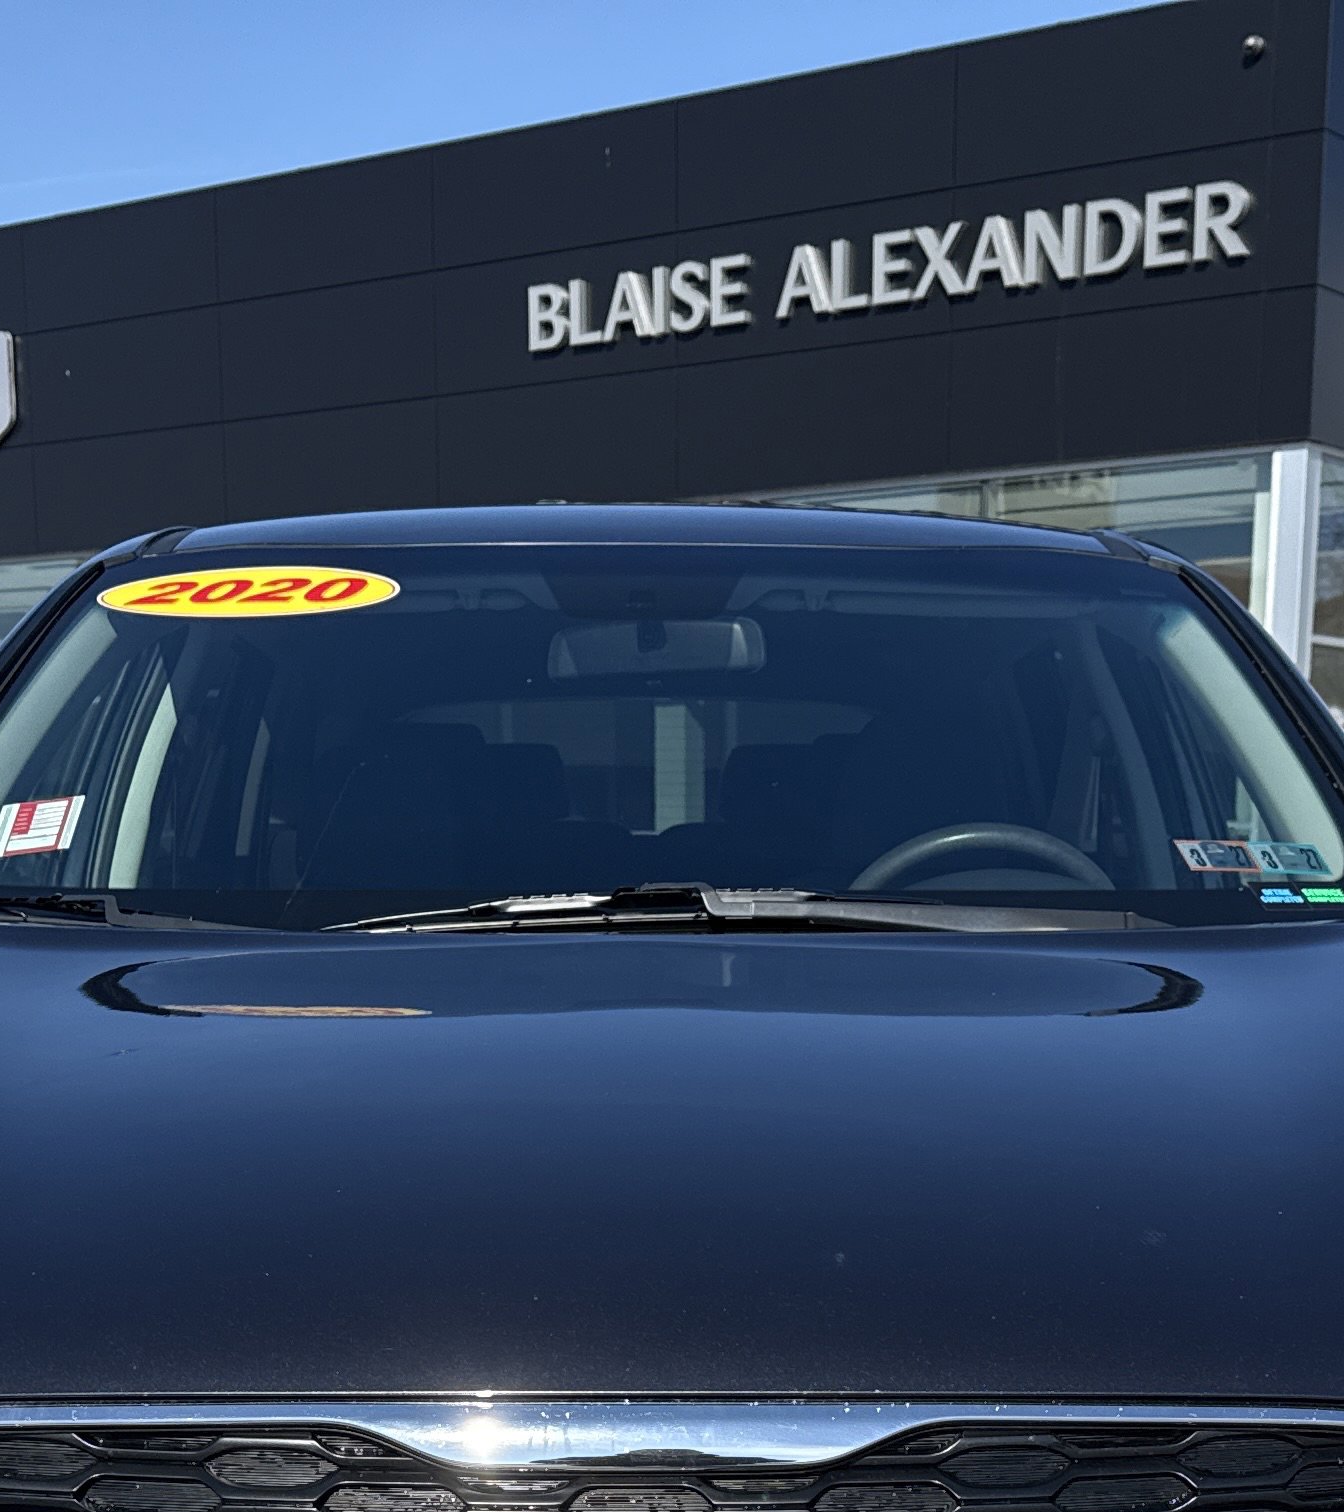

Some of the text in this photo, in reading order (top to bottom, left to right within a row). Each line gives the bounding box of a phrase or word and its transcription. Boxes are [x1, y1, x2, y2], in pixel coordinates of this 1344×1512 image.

[527, 180, 1254, 352] BLAISE ALEXANDER
[124, 577, 369, 606] 2020
[1189, 848, 1207, 867] 3
[1260, 849, 1279, 869] 3
